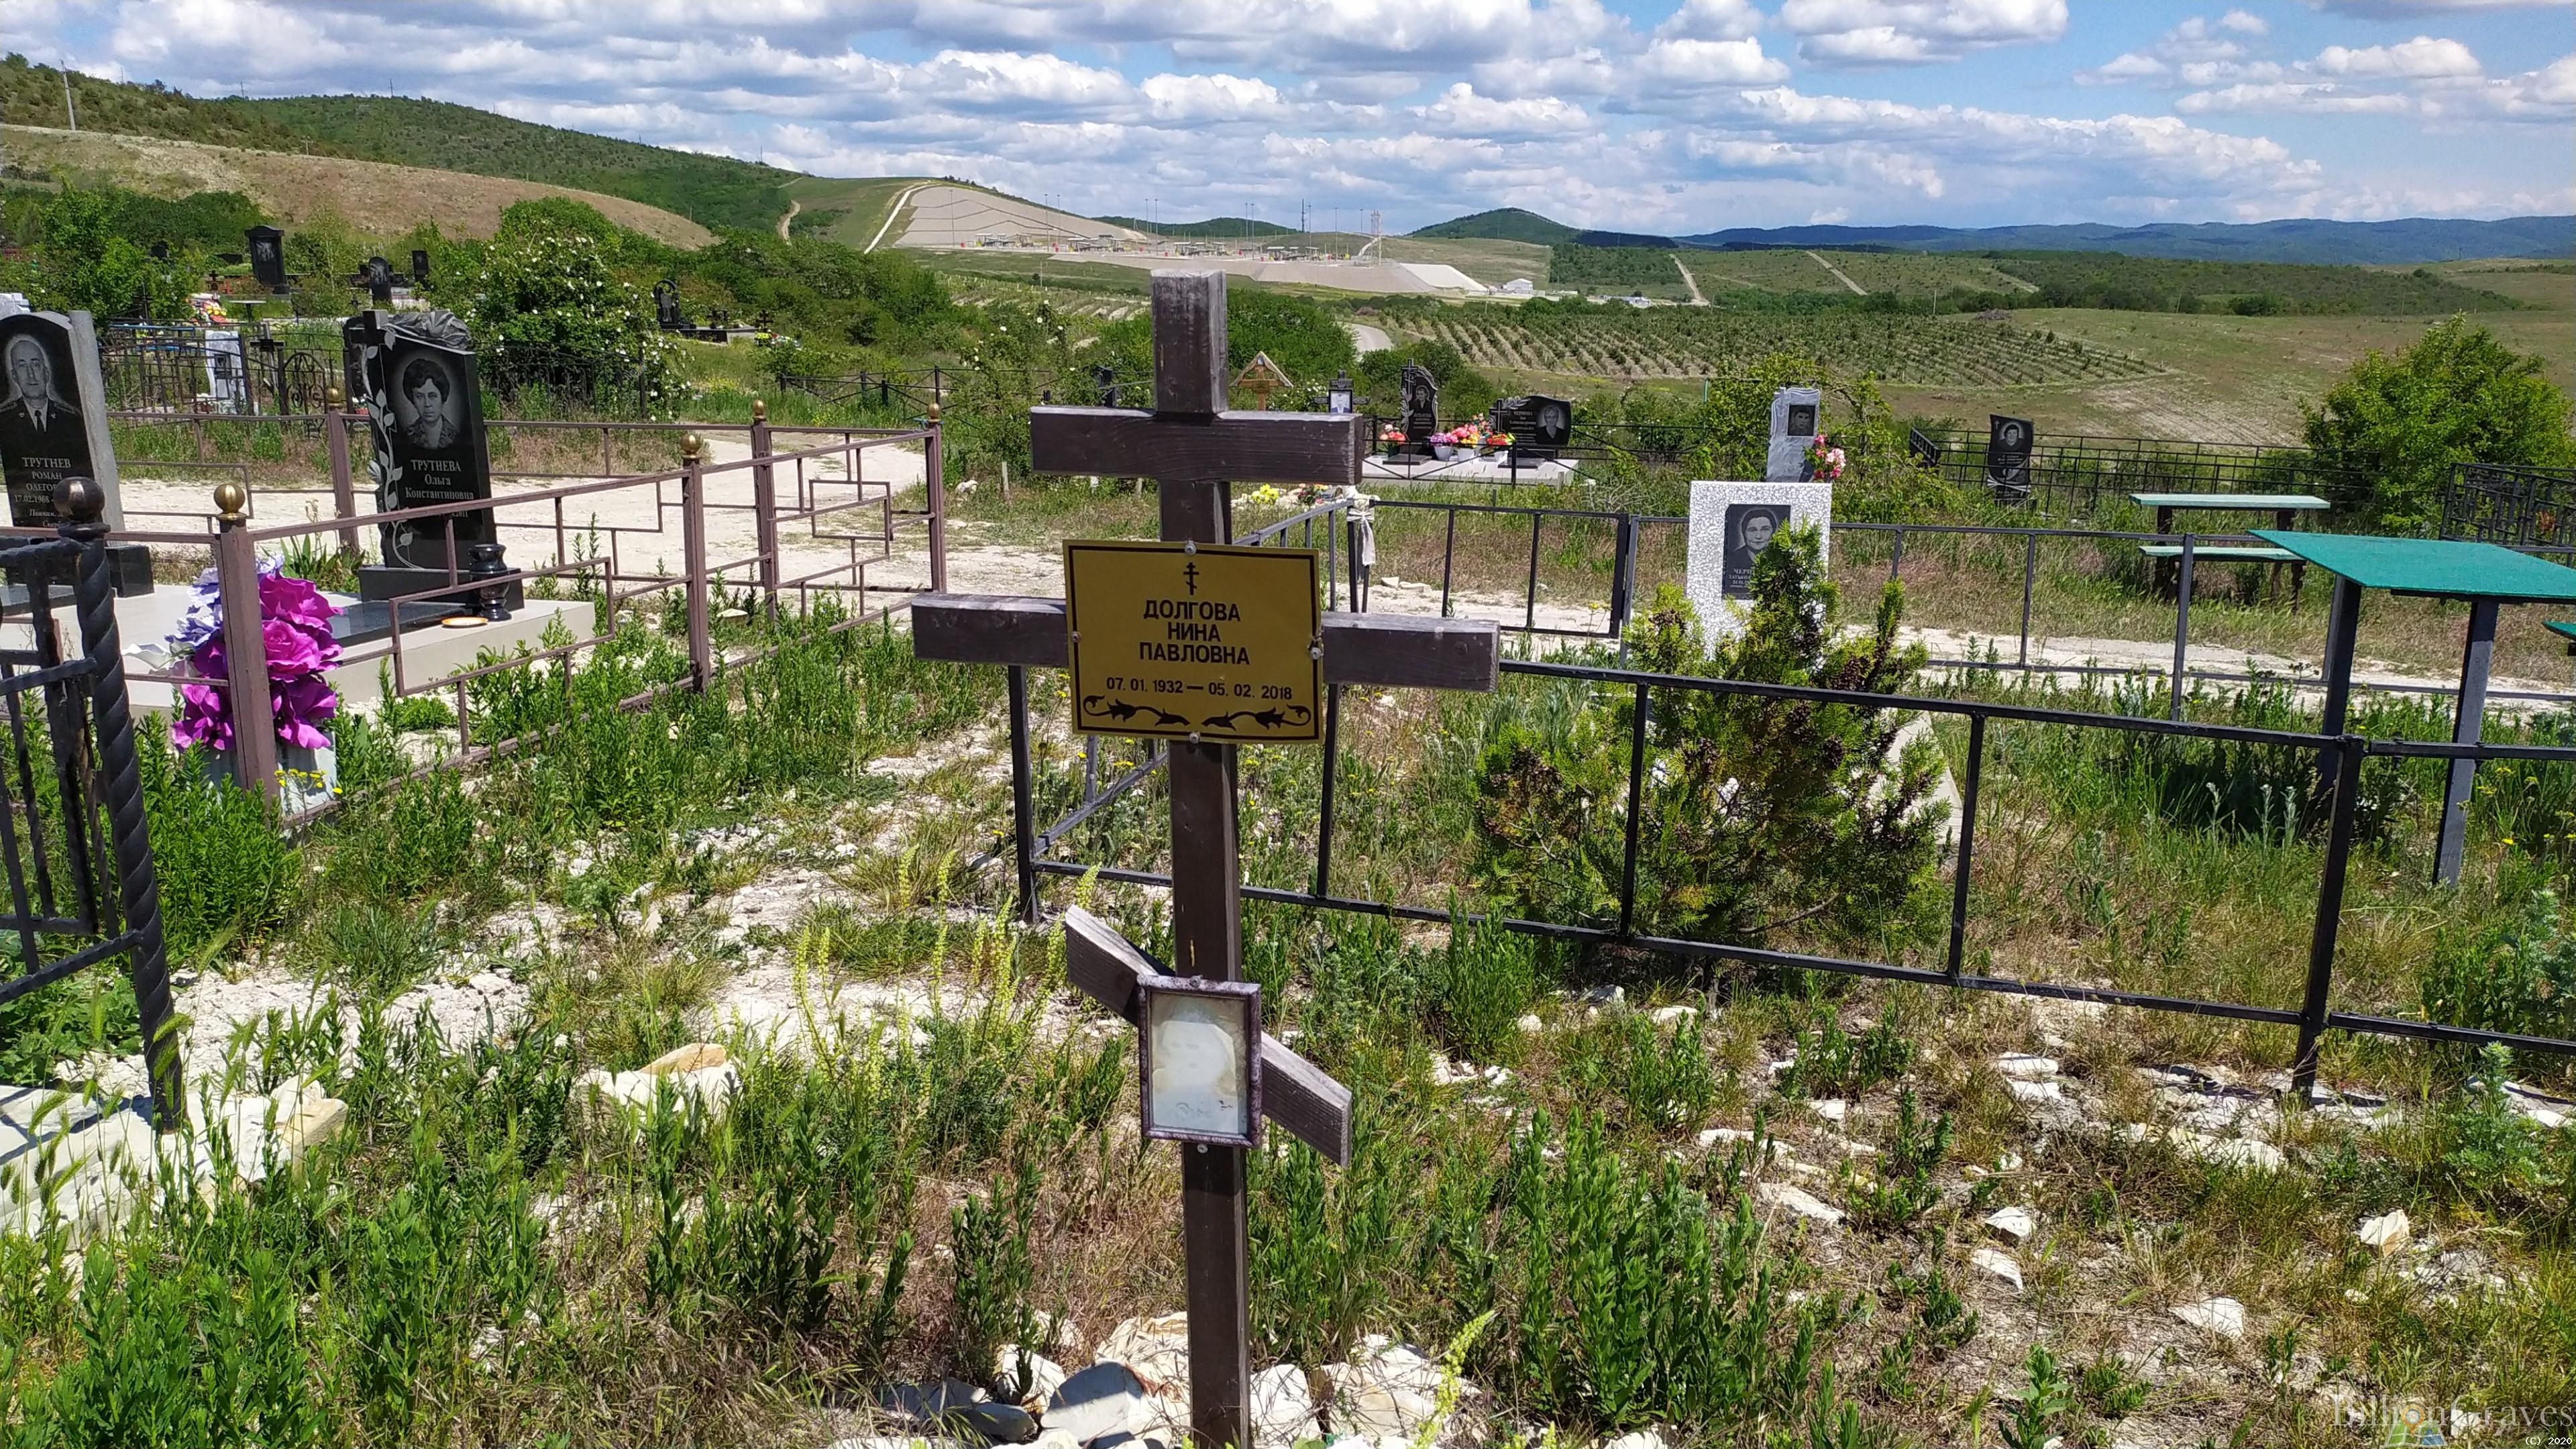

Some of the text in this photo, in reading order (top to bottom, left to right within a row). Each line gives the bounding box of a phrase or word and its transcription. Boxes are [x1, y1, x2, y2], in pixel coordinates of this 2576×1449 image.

[21, 457, 71, 468] ТРУТНЕВ
[411, 460, 462, 472] ТРУТНЕВА
[32, 471, 62, 480] РОМАН
[425, 474, 451, 485] Ольга
[405, 487, 474, 500] Константиновна
[1143, 599, 1241, 621] ДОЛГОВА
[1168, 621, 1221, 642] НИНА
[1140, 642, 1250, 665] ПАВЛОВНА
